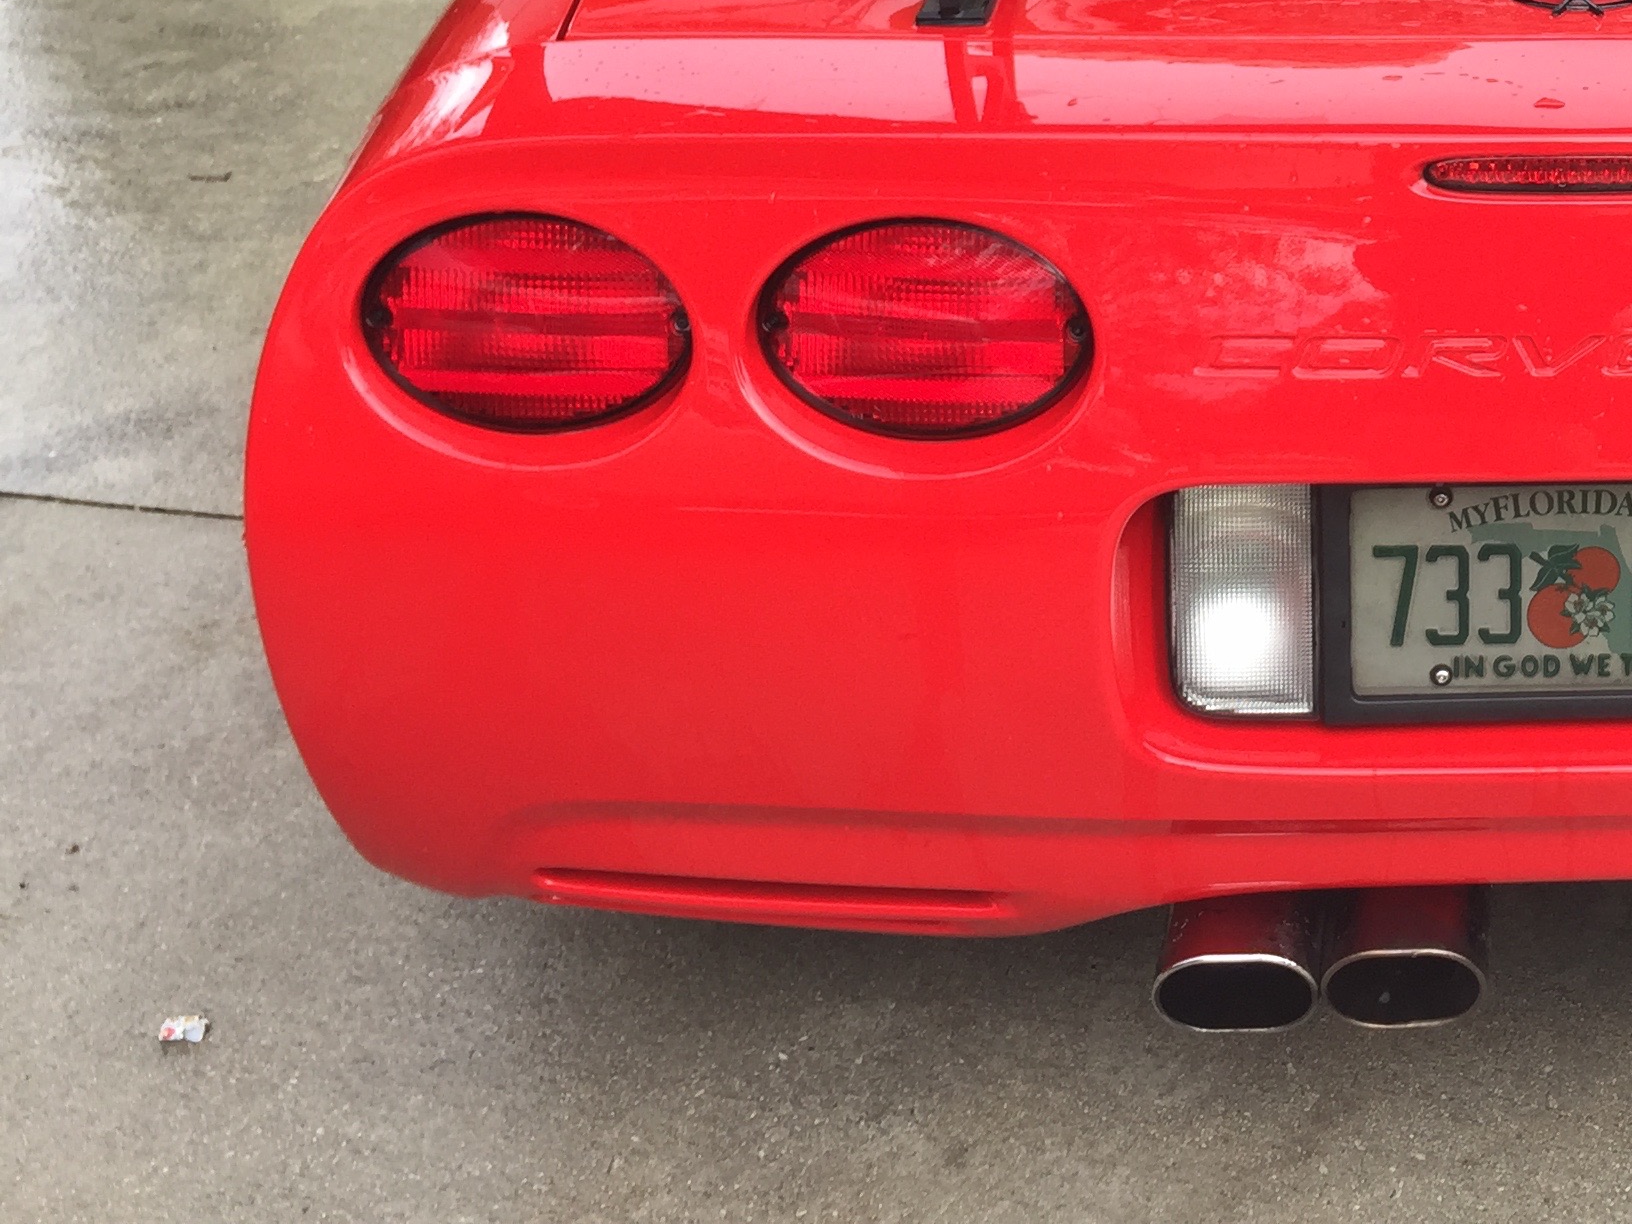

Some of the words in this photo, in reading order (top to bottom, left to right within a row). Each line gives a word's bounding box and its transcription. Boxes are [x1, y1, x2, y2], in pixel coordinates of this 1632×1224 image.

[1371, 541, 1523, 647] 733
[1452, 654, 1485, 679] IN
[1492, 653, 1562, 679] GOD
[1568, 651, 1613, 677] WE
